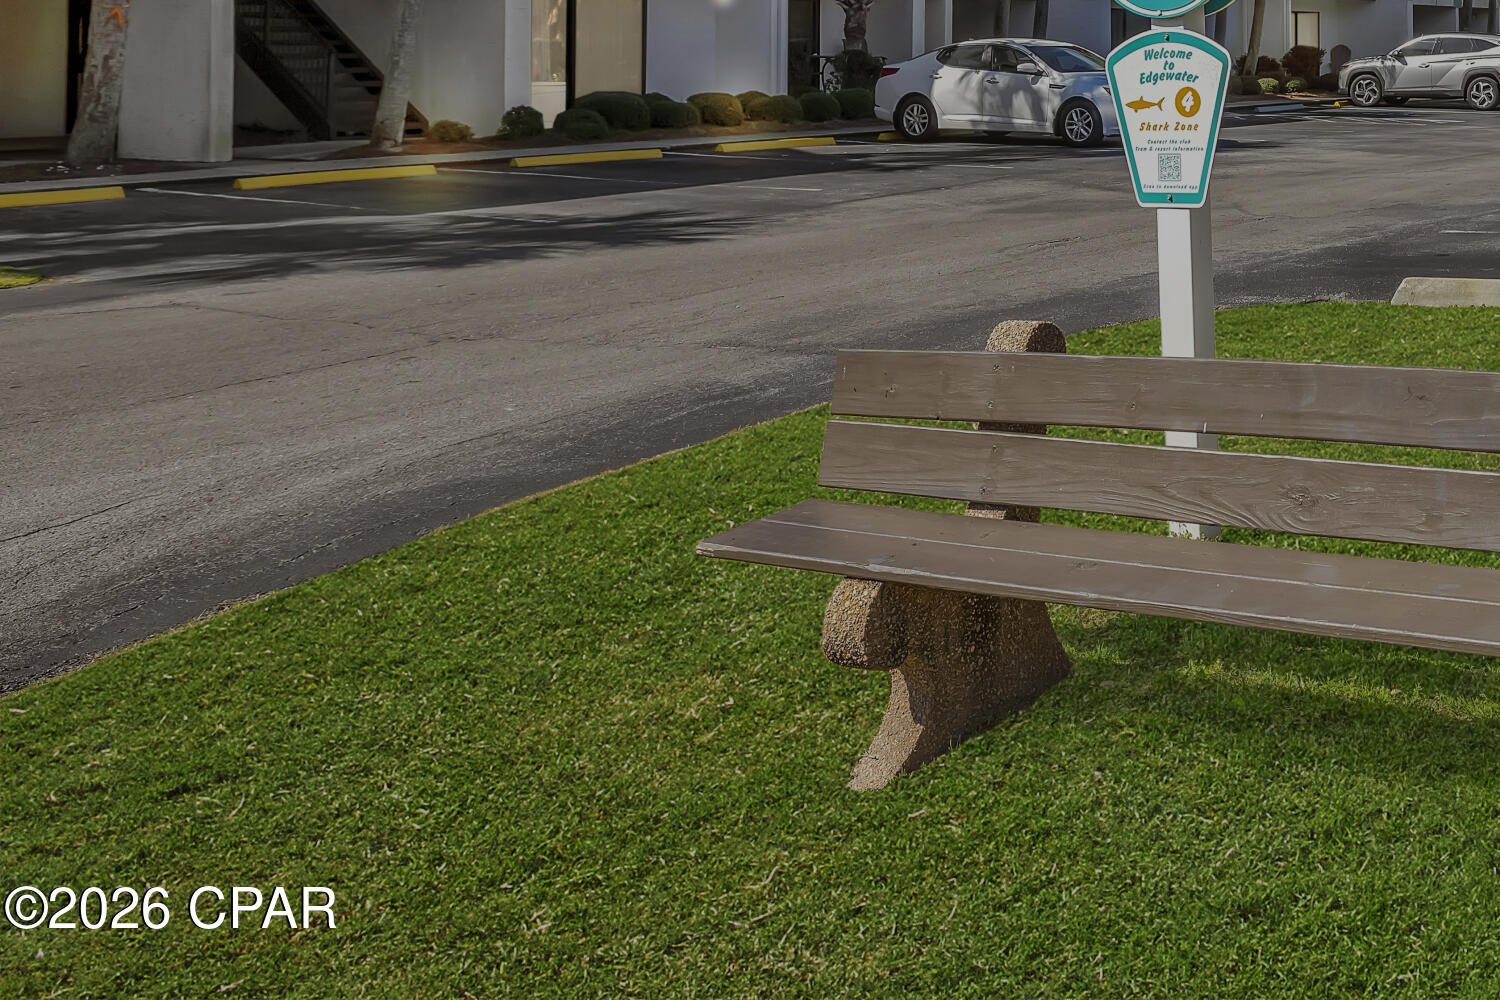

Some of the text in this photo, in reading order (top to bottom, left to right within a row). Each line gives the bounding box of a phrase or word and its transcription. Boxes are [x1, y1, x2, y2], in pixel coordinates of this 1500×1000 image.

[1144, 48, 1193, 61] Welcome
[1163, 60, 1175, 70] to
[1139, 71, 1199, 86] Edgewater
[1139, 121, 1199, 132] Shark Zone
